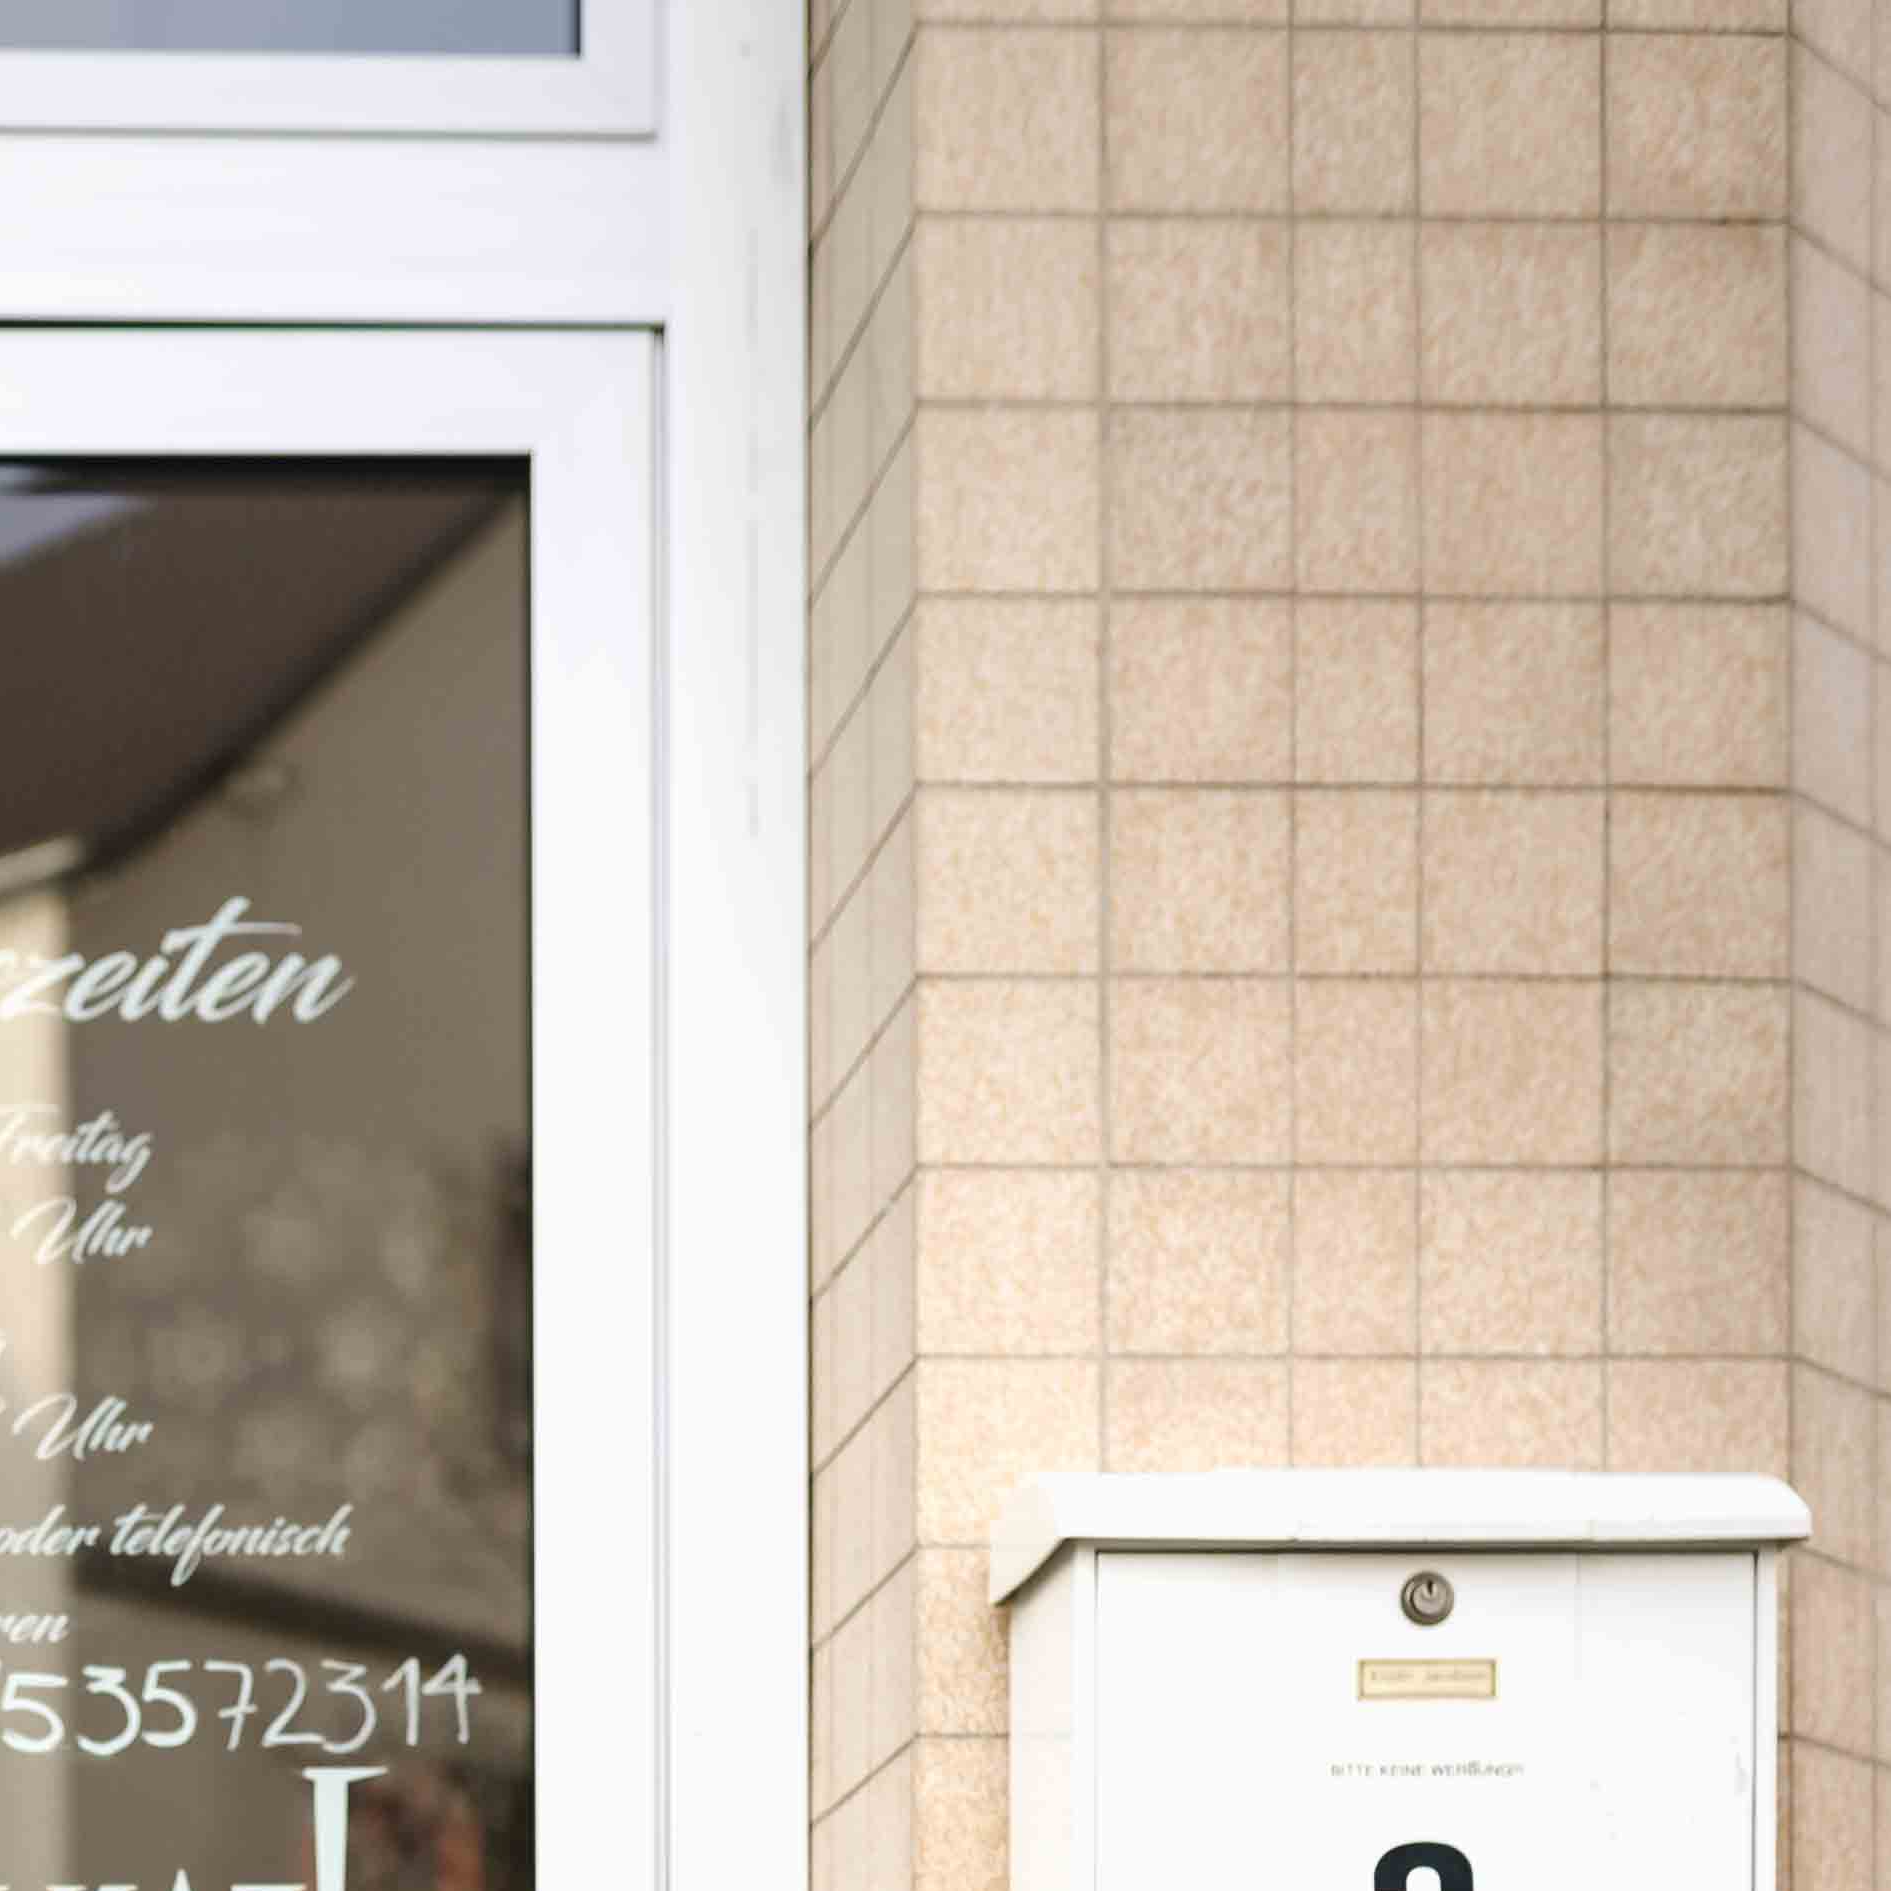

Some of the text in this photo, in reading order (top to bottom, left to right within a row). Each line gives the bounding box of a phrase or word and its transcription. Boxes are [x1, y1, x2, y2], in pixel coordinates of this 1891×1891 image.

[9, 1195, 153, 1264] Uhr
[12, 1393, 154, 1462] Uhr
[110, 1503, 354, 1586] telefonisch
